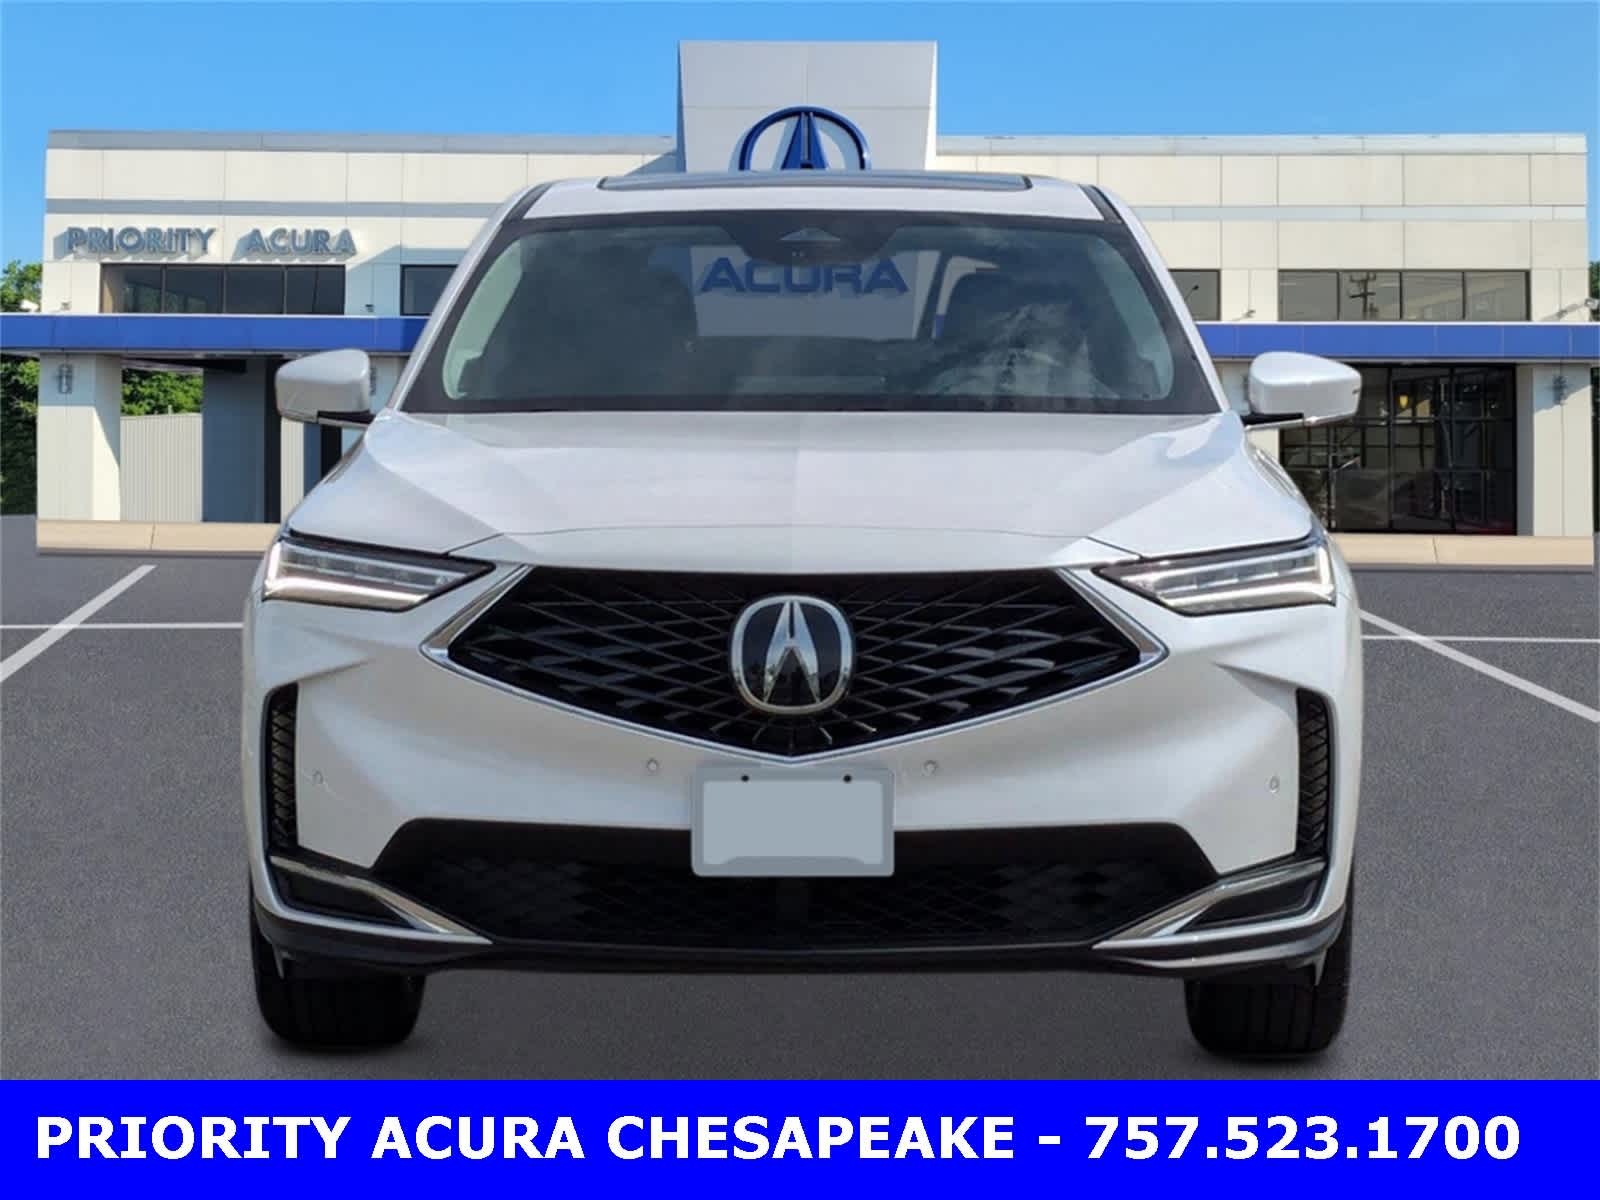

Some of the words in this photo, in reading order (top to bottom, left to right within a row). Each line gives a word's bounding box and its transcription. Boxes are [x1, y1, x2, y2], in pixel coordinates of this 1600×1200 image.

[66, 226, 216, 256] PRIORITY
[247, 228, 357, 257] ACURA
[700, 256, 909, 294] ACURA
